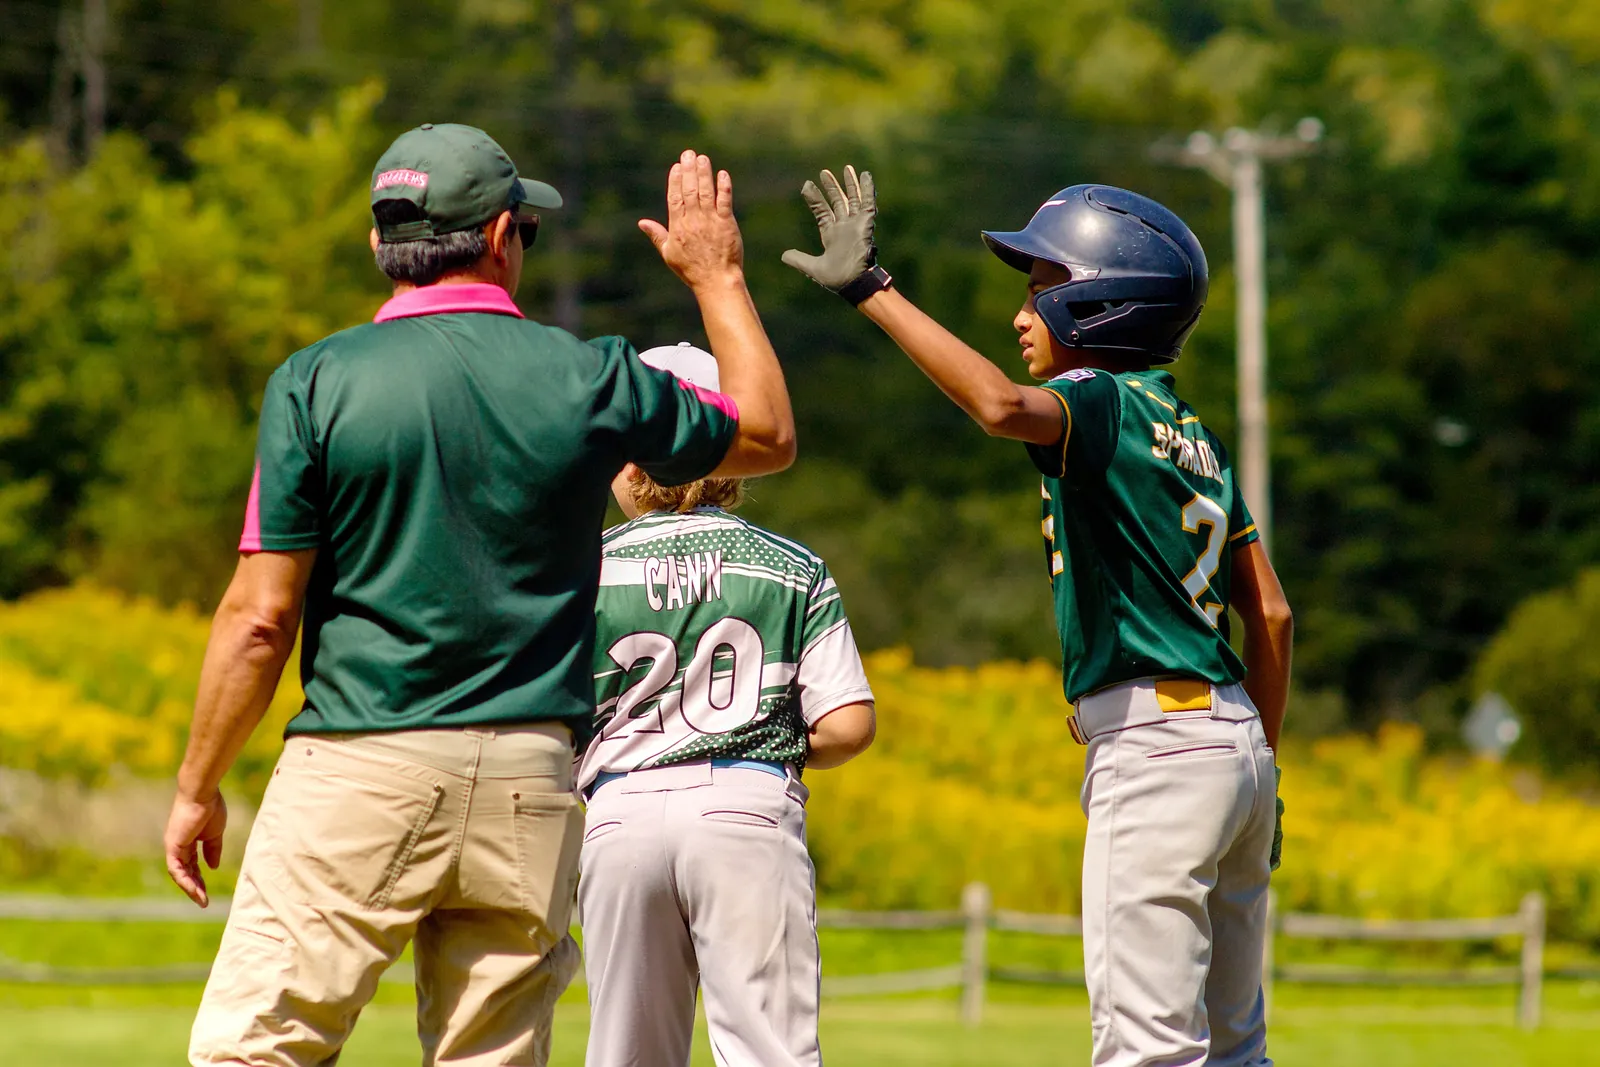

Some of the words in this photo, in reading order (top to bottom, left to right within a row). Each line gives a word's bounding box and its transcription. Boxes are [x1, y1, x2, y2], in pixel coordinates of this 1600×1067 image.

[644, 549, 722, 612] CANN
[1180, 492, 1228, 629] 2
[600, 616, 765, 741] 20
